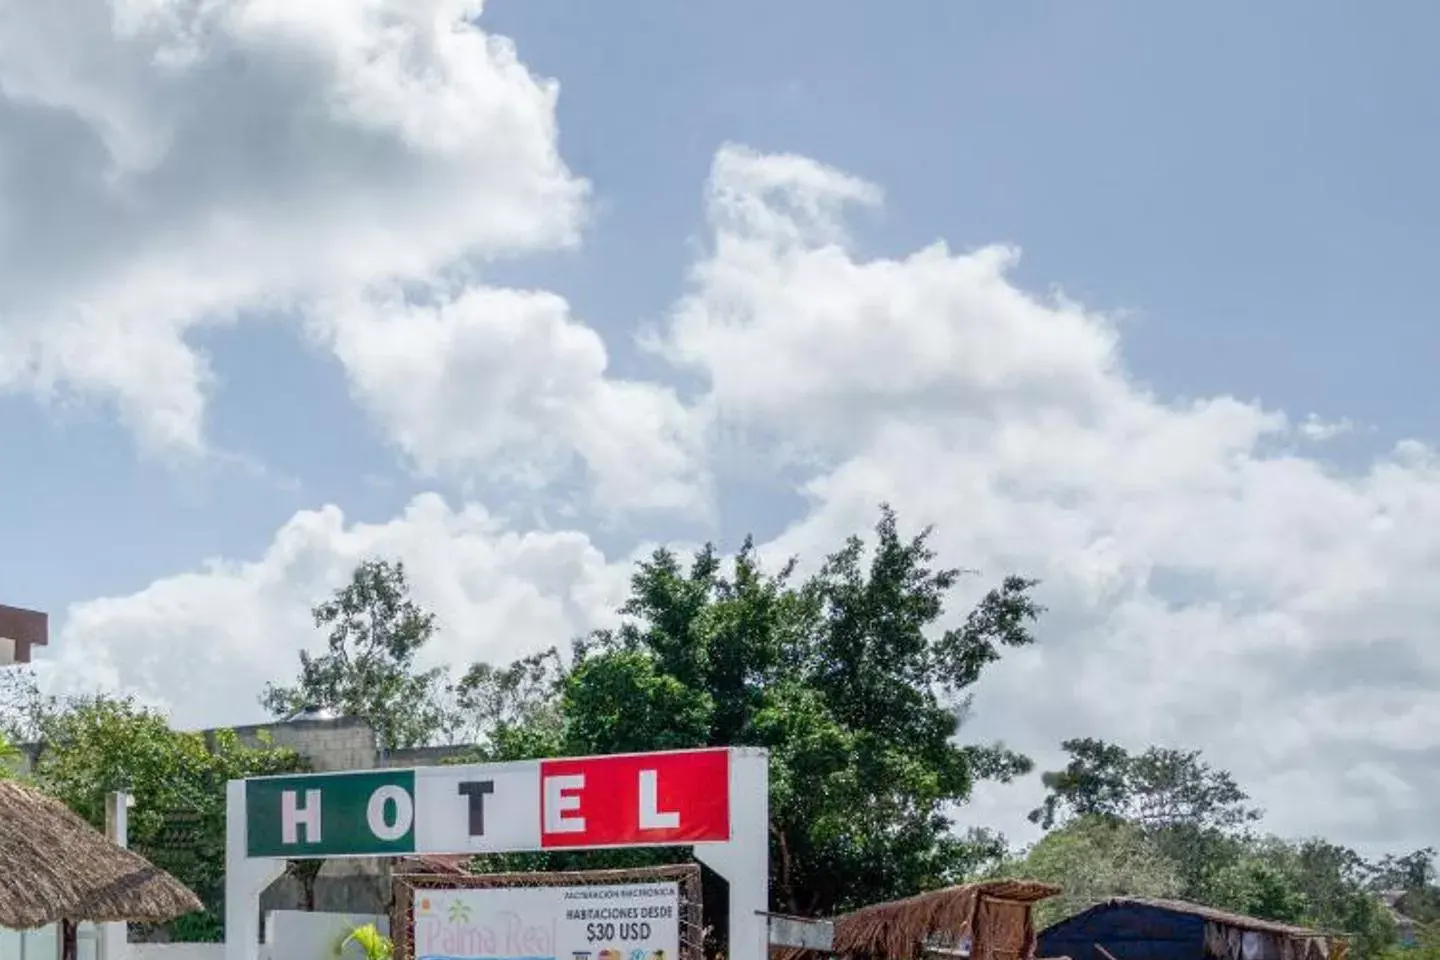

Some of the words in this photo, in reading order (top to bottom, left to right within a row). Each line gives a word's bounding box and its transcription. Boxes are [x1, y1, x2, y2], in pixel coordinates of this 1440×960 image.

[280, 769, 681, 845] HOTEL
[640, 905, 673, 919] DESDE
[421, 913, 497, 955] Palma
[497, 909, 558, 956] Real
[586, 921, 615, 944] $30
[619, 921, 651, 941] USD
